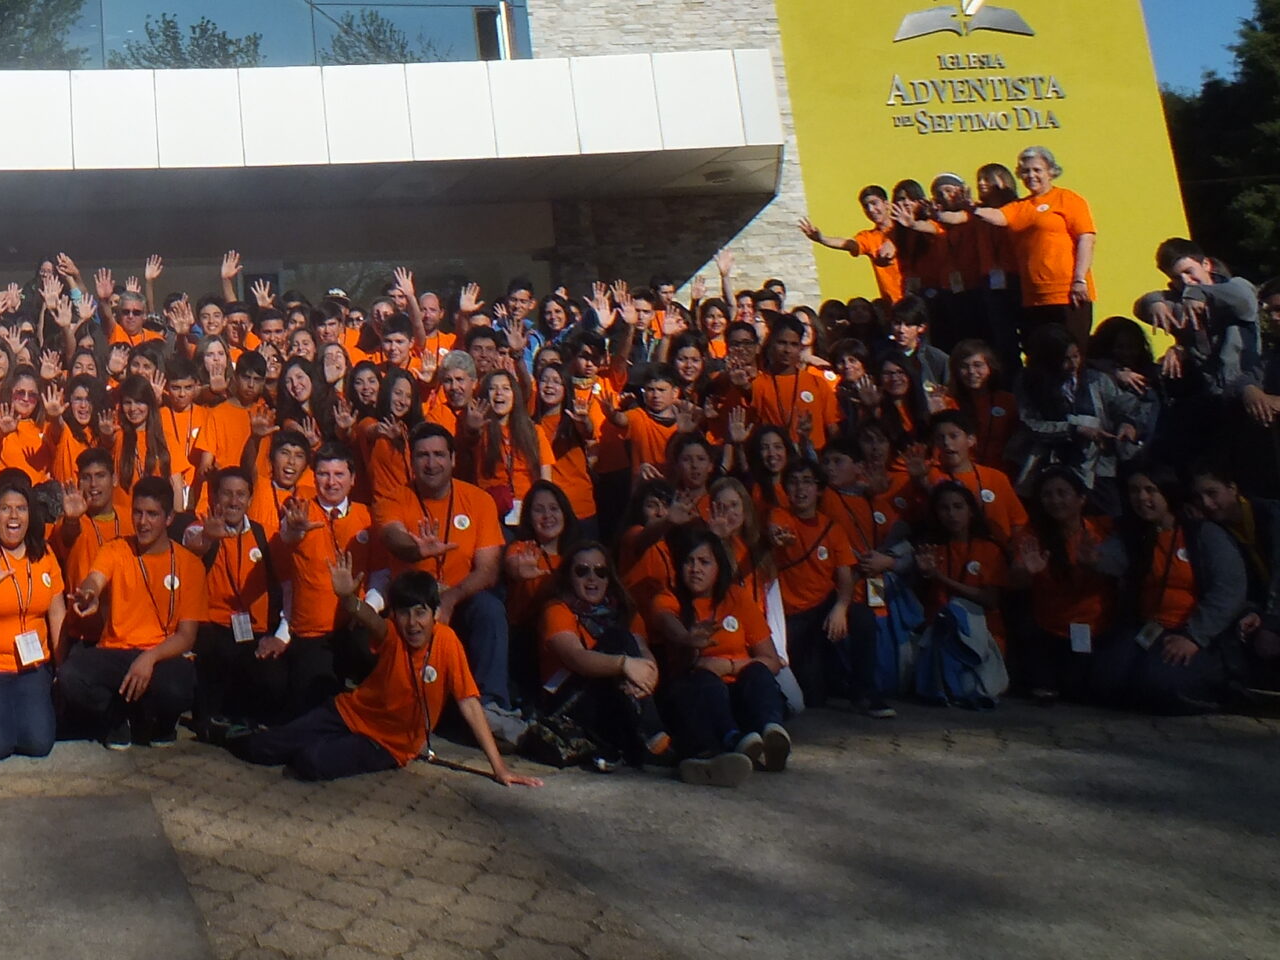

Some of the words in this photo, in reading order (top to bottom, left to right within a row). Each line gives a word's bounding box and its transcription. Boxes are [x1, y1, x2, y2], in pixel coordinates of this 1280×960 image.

[937, 53, 1005, 70] IGLESIA
[886, 73, 1065, 106] ADVENTISTA
[893, 115, 914, 127] DEL
[915, 108, 1011, 134] SEPTIMO
